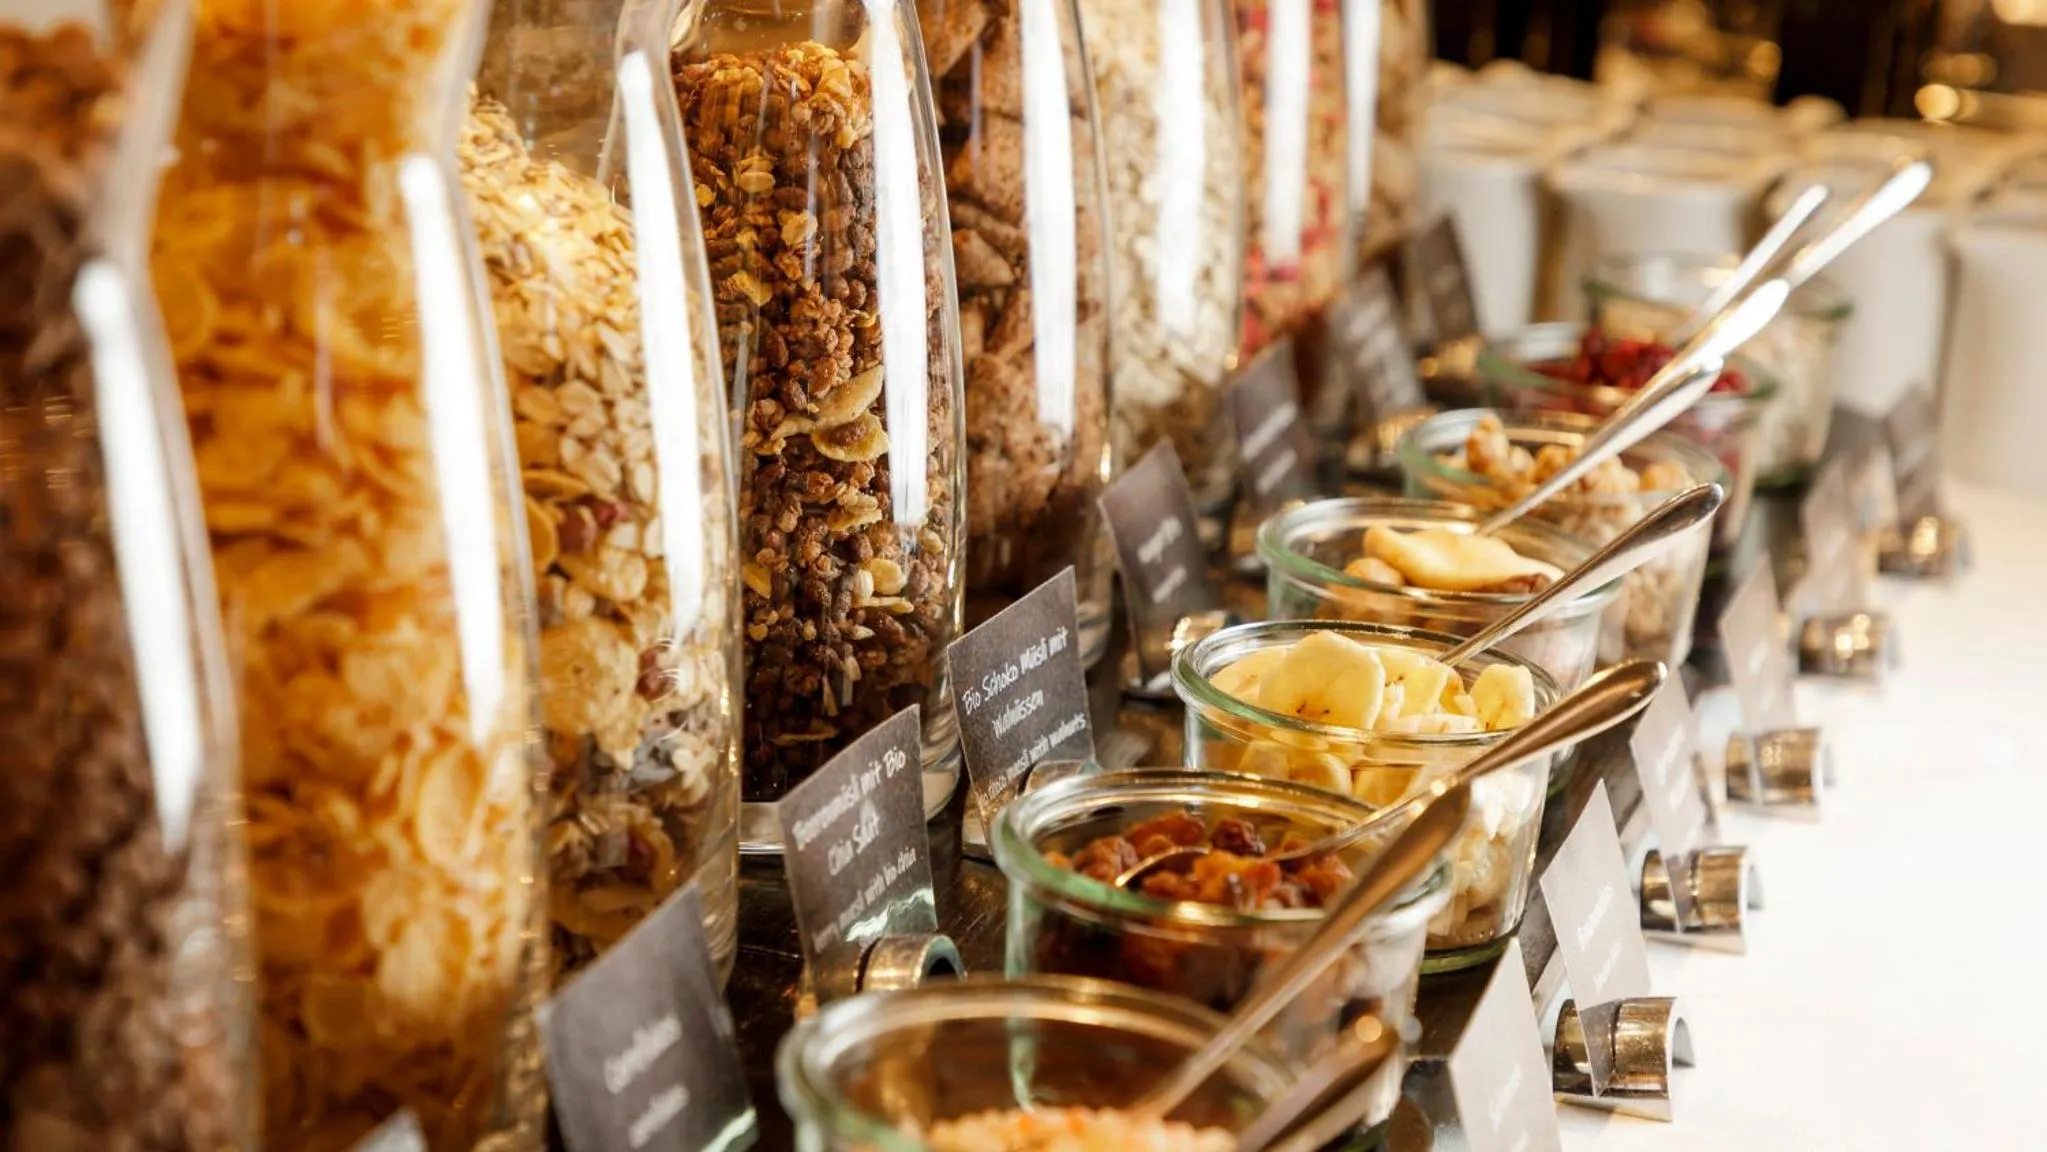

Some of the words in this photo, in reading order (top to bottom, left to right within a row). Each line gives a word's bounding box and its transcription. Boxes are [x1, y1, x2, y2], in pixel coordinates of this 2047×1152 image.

[962, 688, 981, 715] Bio
[982, 662, 1018, 700] Schoko
[1048, 626, 1068, 658] mit
[860, 760, 882, 794] mit
[882, 746, 906, 778] Bio
